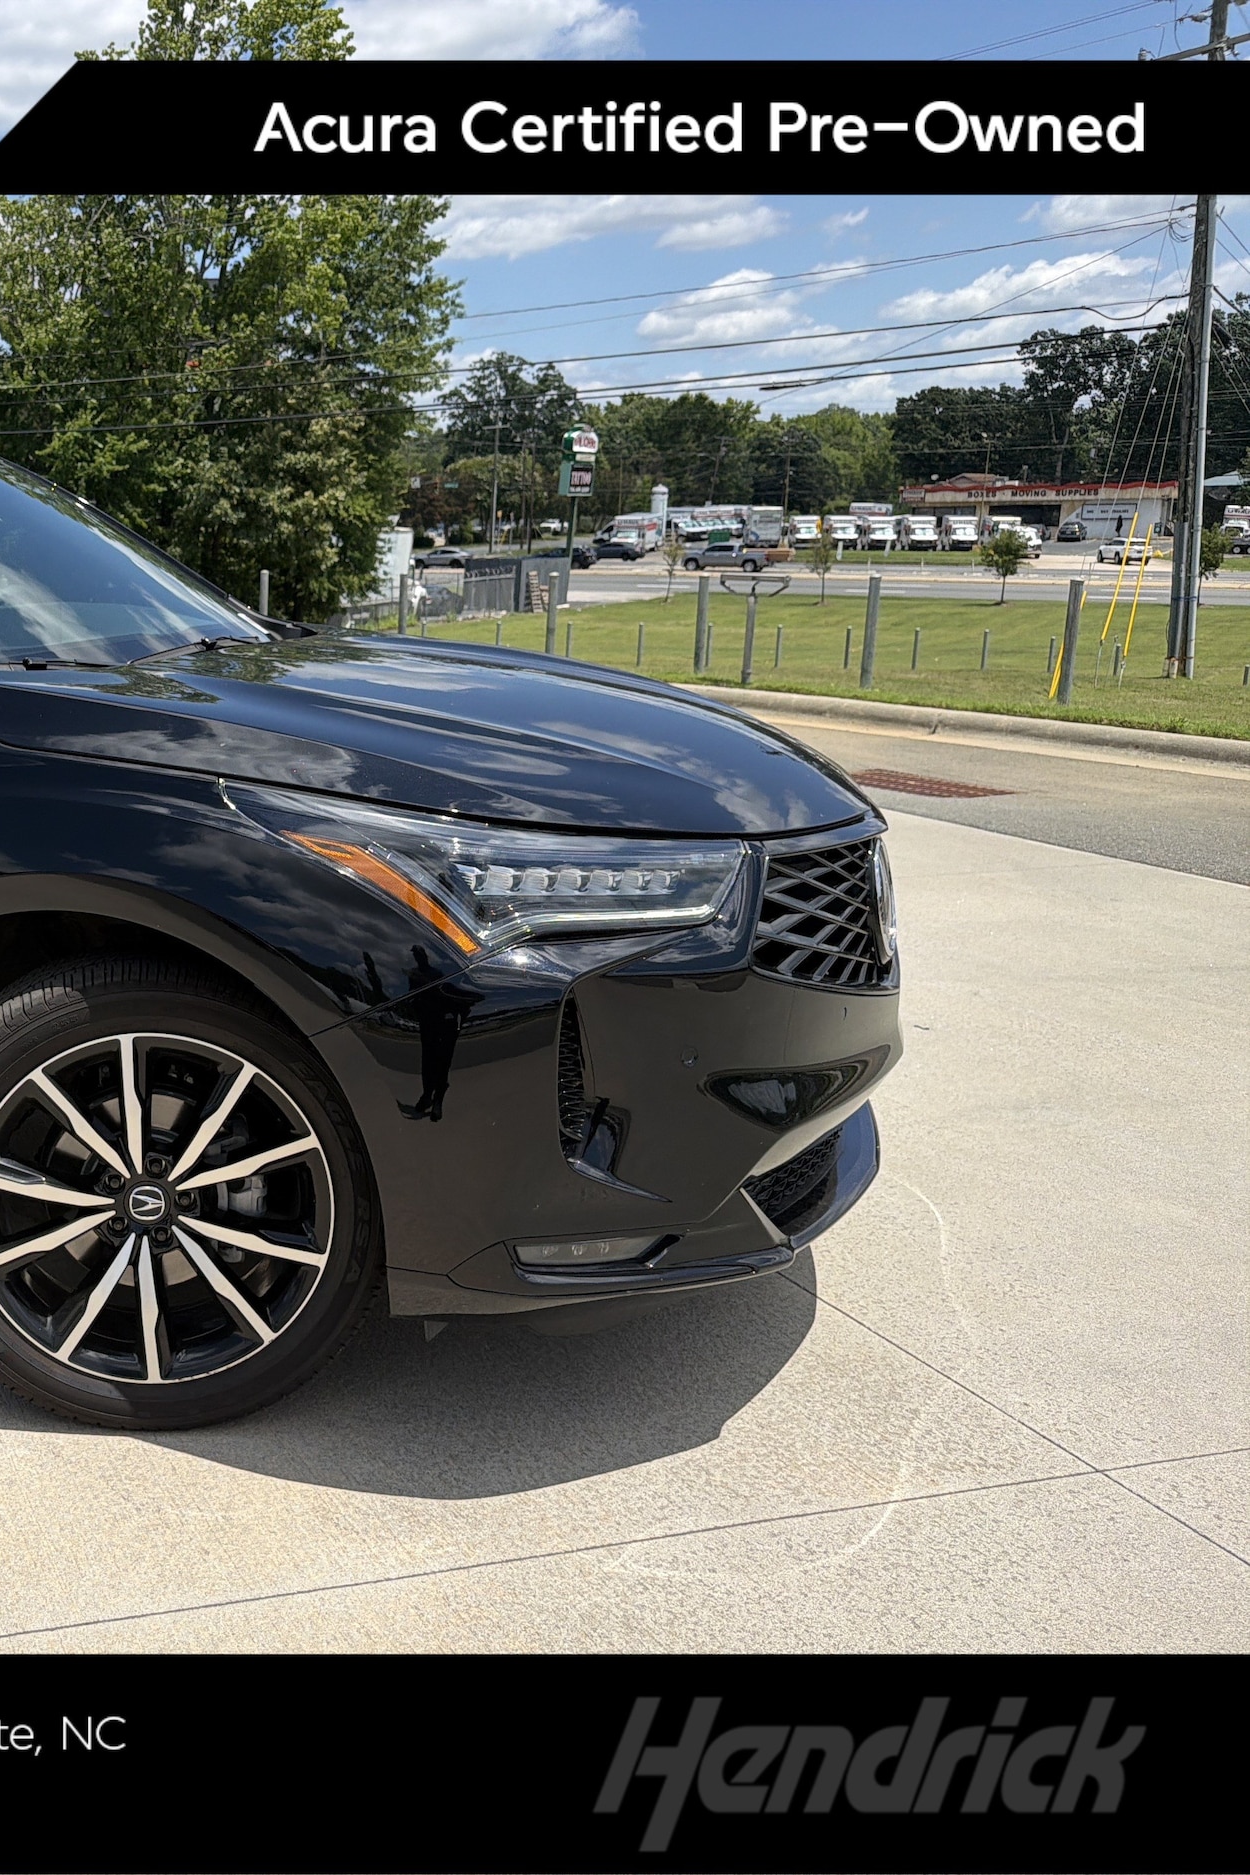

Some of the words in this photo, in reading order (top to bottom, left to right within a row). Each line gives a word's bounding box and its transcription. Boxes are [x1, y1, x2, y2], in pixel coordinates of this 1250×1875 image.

[967, 491, 997, 499] BOXES
[1011, 490, 1047, 498] MOVING
[1055, 489, 1099, 497] SUPPLIES
